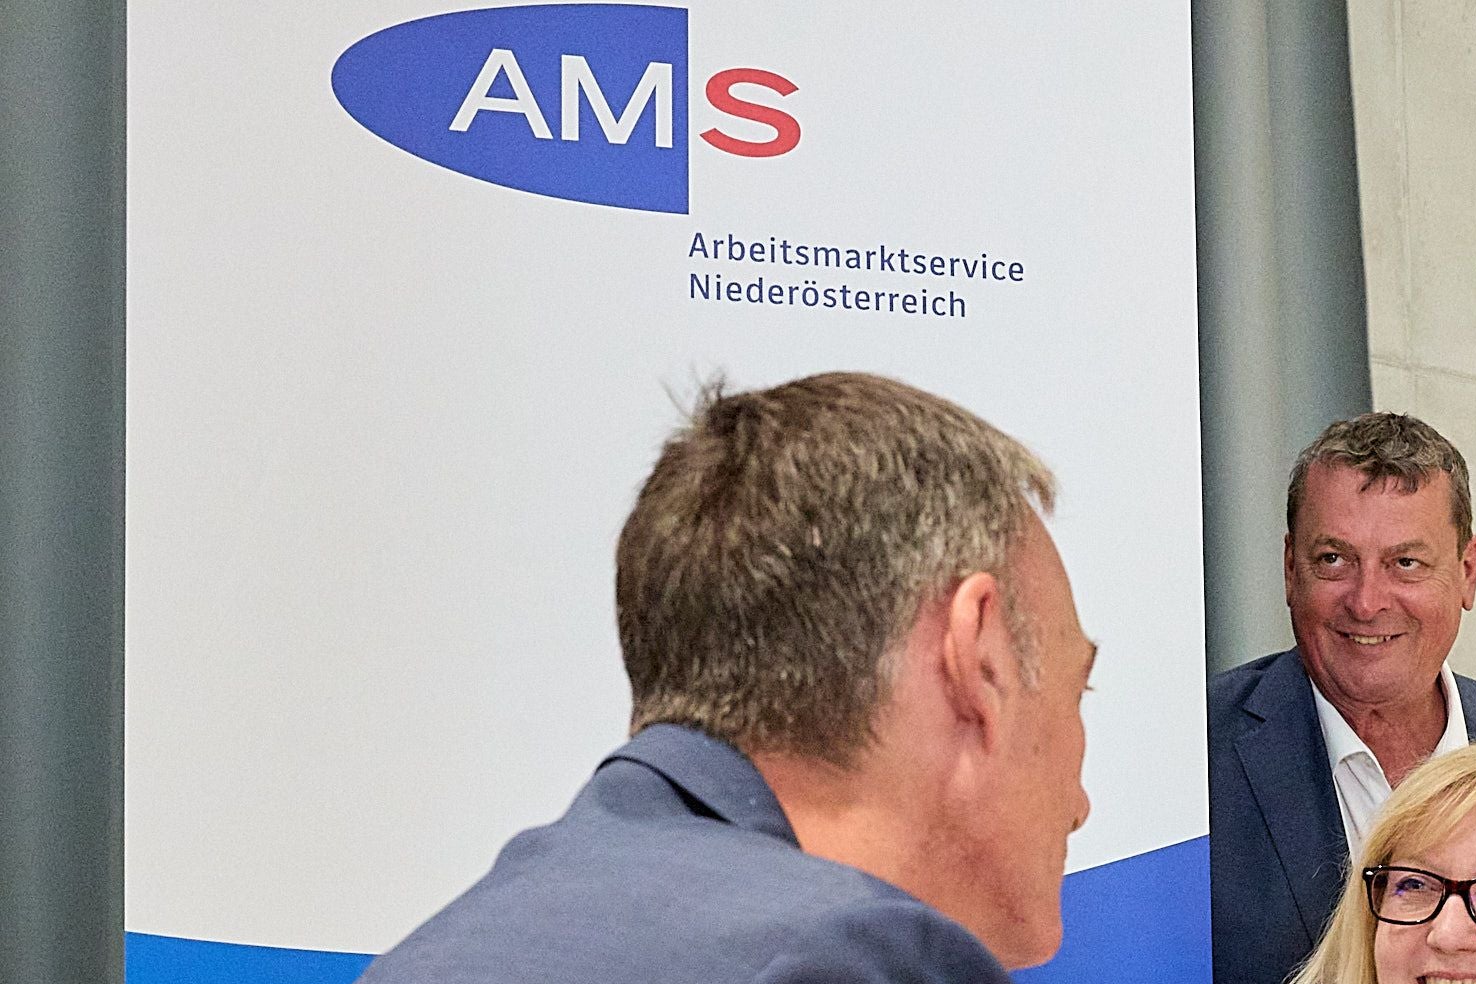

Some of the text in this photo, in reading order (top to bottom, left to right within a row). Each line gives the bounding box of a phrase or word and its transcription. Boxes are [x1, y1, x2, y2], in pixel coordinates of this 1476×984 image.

[449, 48, 801, 157] AMS
[689, 231, 1025, 284] Arbeitsmarktservice
[689, 273, 967, 318] Niederösterreich
